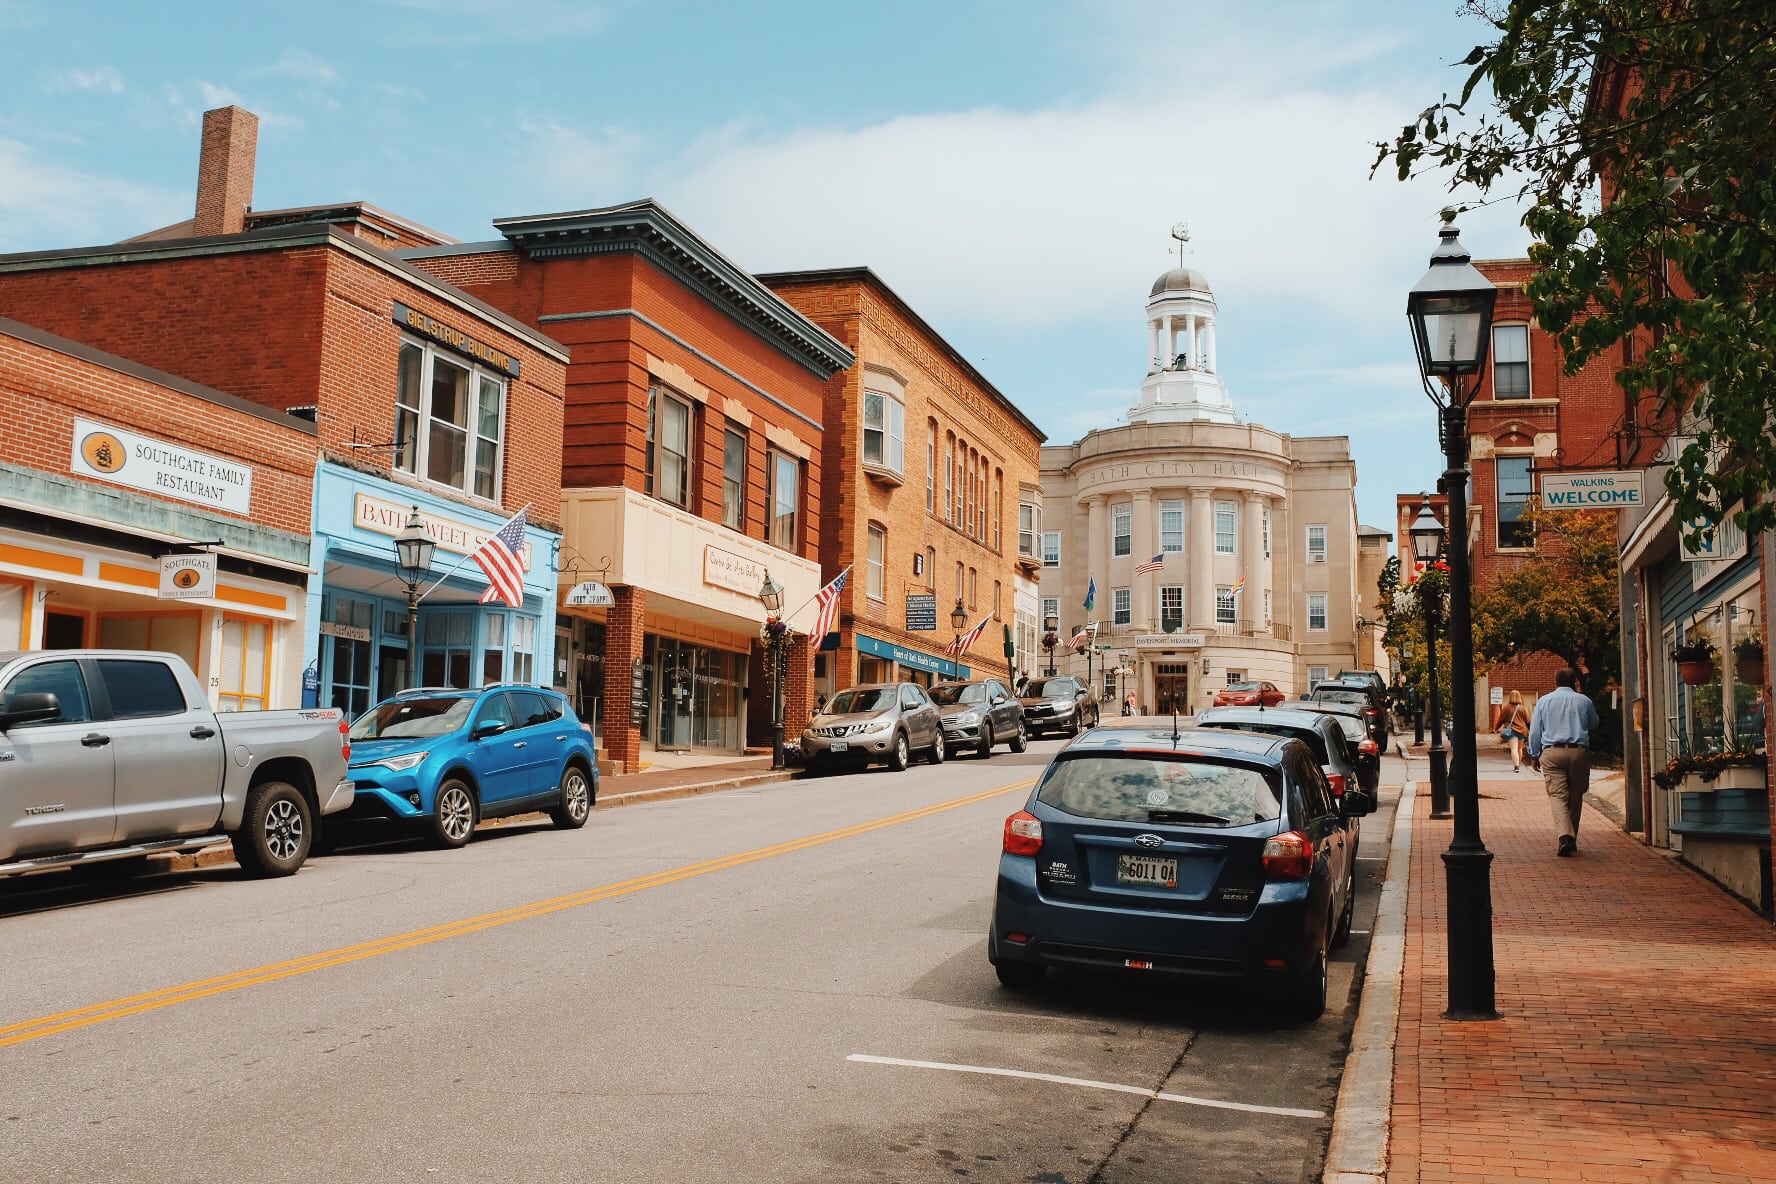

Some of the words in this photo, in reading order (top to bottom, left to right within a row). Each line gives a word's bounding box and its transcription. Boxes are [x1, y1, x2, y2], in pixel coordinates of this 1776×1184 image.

[406, 308, 465, 348] GIELSTRUP
[468, 337, 511, 370] BUILDING
[136, 443, 206, 476] SOUTHGATE
[210, 464, 246, 487] FAMILY
[1089, 466, 1130, 484] BATH
[1145, 463, 1196, 476] CITY
[1214, 463, 1258, 478] HALL
[157, 471, 226, 502] RESTAURANT
[1570, 477, 1615, 488] WALKINS
[1547, 489, 1640, 505] WELCOME
[362, 502, 408, 529] BATH
[424, 517, 470, 548] WEET
[164, 558, 210, 571] SOUTHGATE
[571, 595, 586, 604] WEET
[894, 648, 904, 659] Heart
[307, 668, 315, 677] 23
[210, 677, 219, 687] 25
[25, 803, 65, 816] TUNDRA
[1129, 862, 1156, 880] 6011
